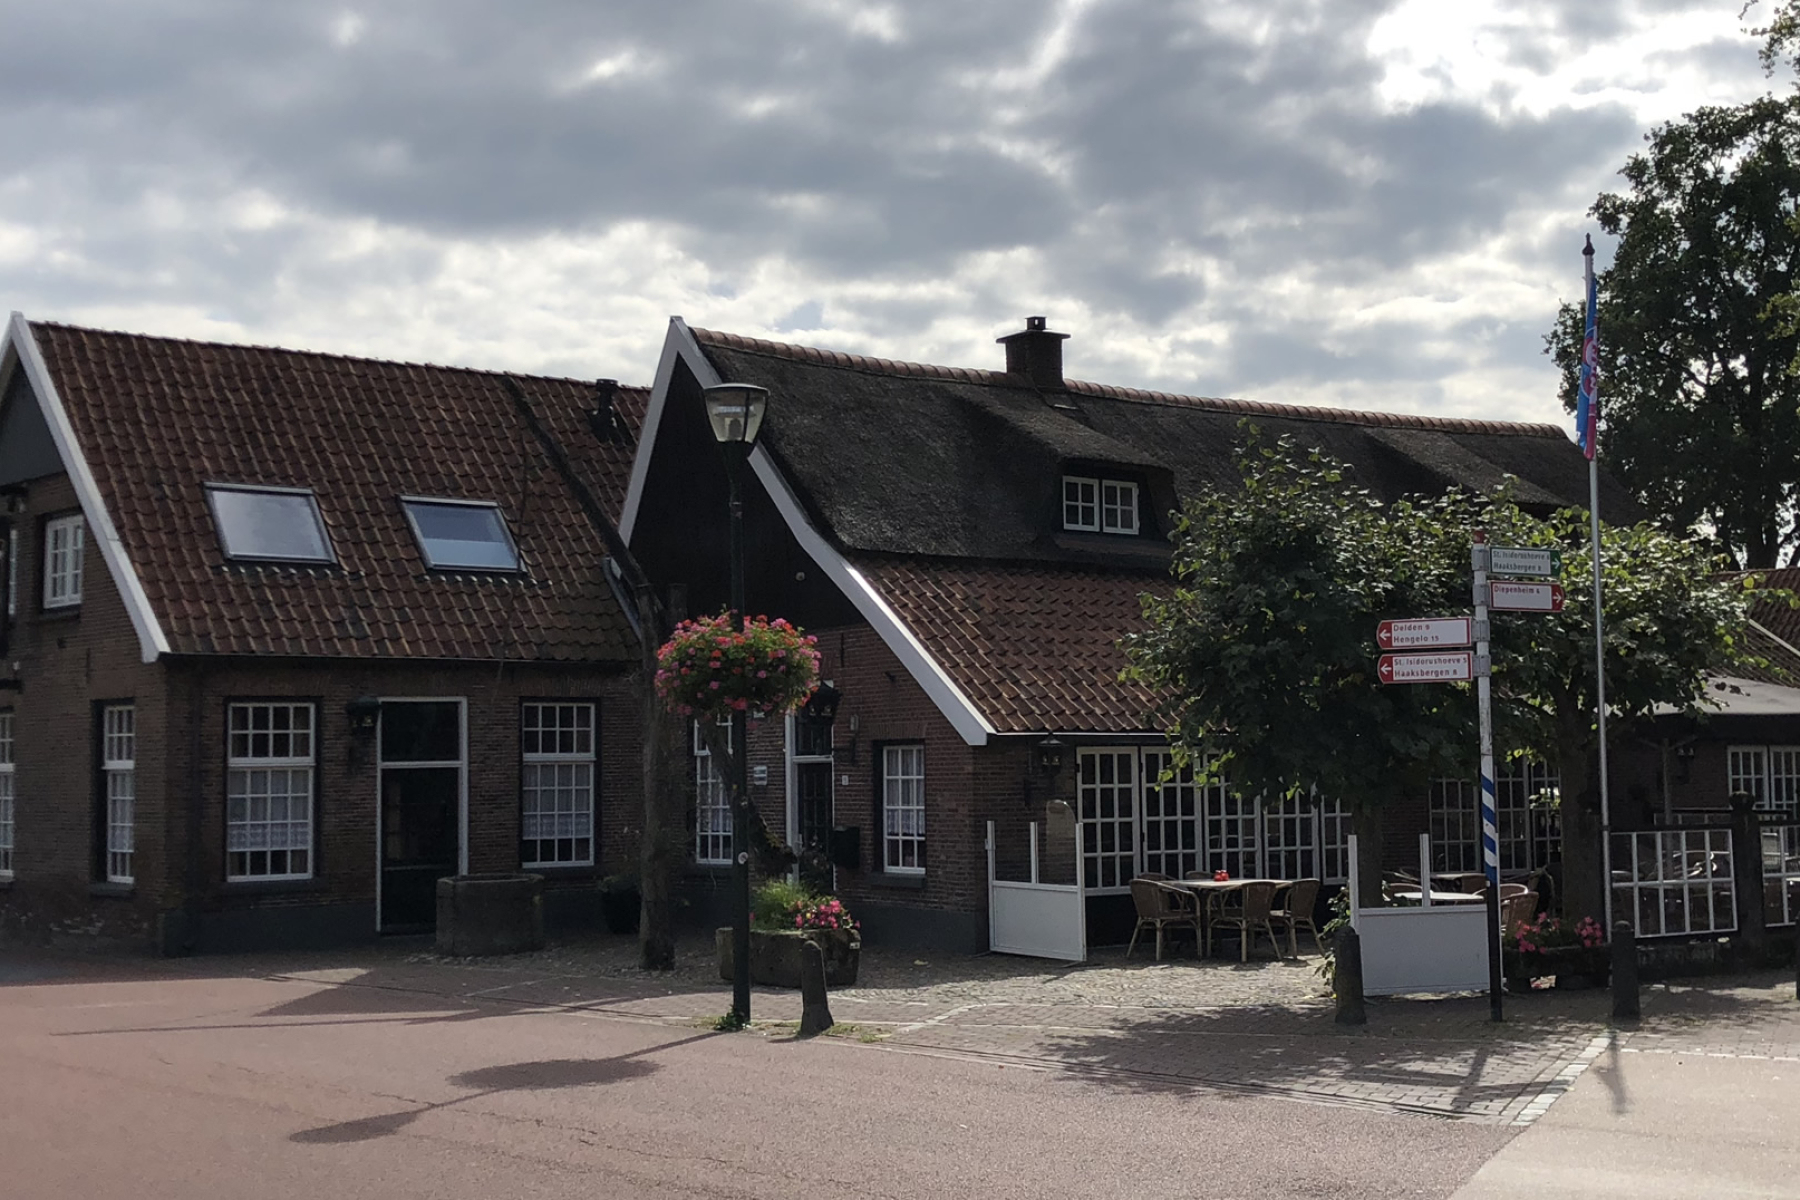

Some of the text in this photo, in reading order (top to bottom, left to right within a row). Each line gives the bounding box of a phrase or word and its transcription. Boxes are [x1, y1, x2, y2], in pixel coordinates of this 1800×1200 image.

[1493, 562, 1535, 572] Haaksbergen
[1494, 585, 1534, 594] Diepenheim
[1393, 624, 1423, 632] Delden
[1393, 635, 1428, 644] Hengelo
[1406, 657, 1461, 665] Isidorushoeve
[1394, 669, 1450, 678] Haaksbergen
